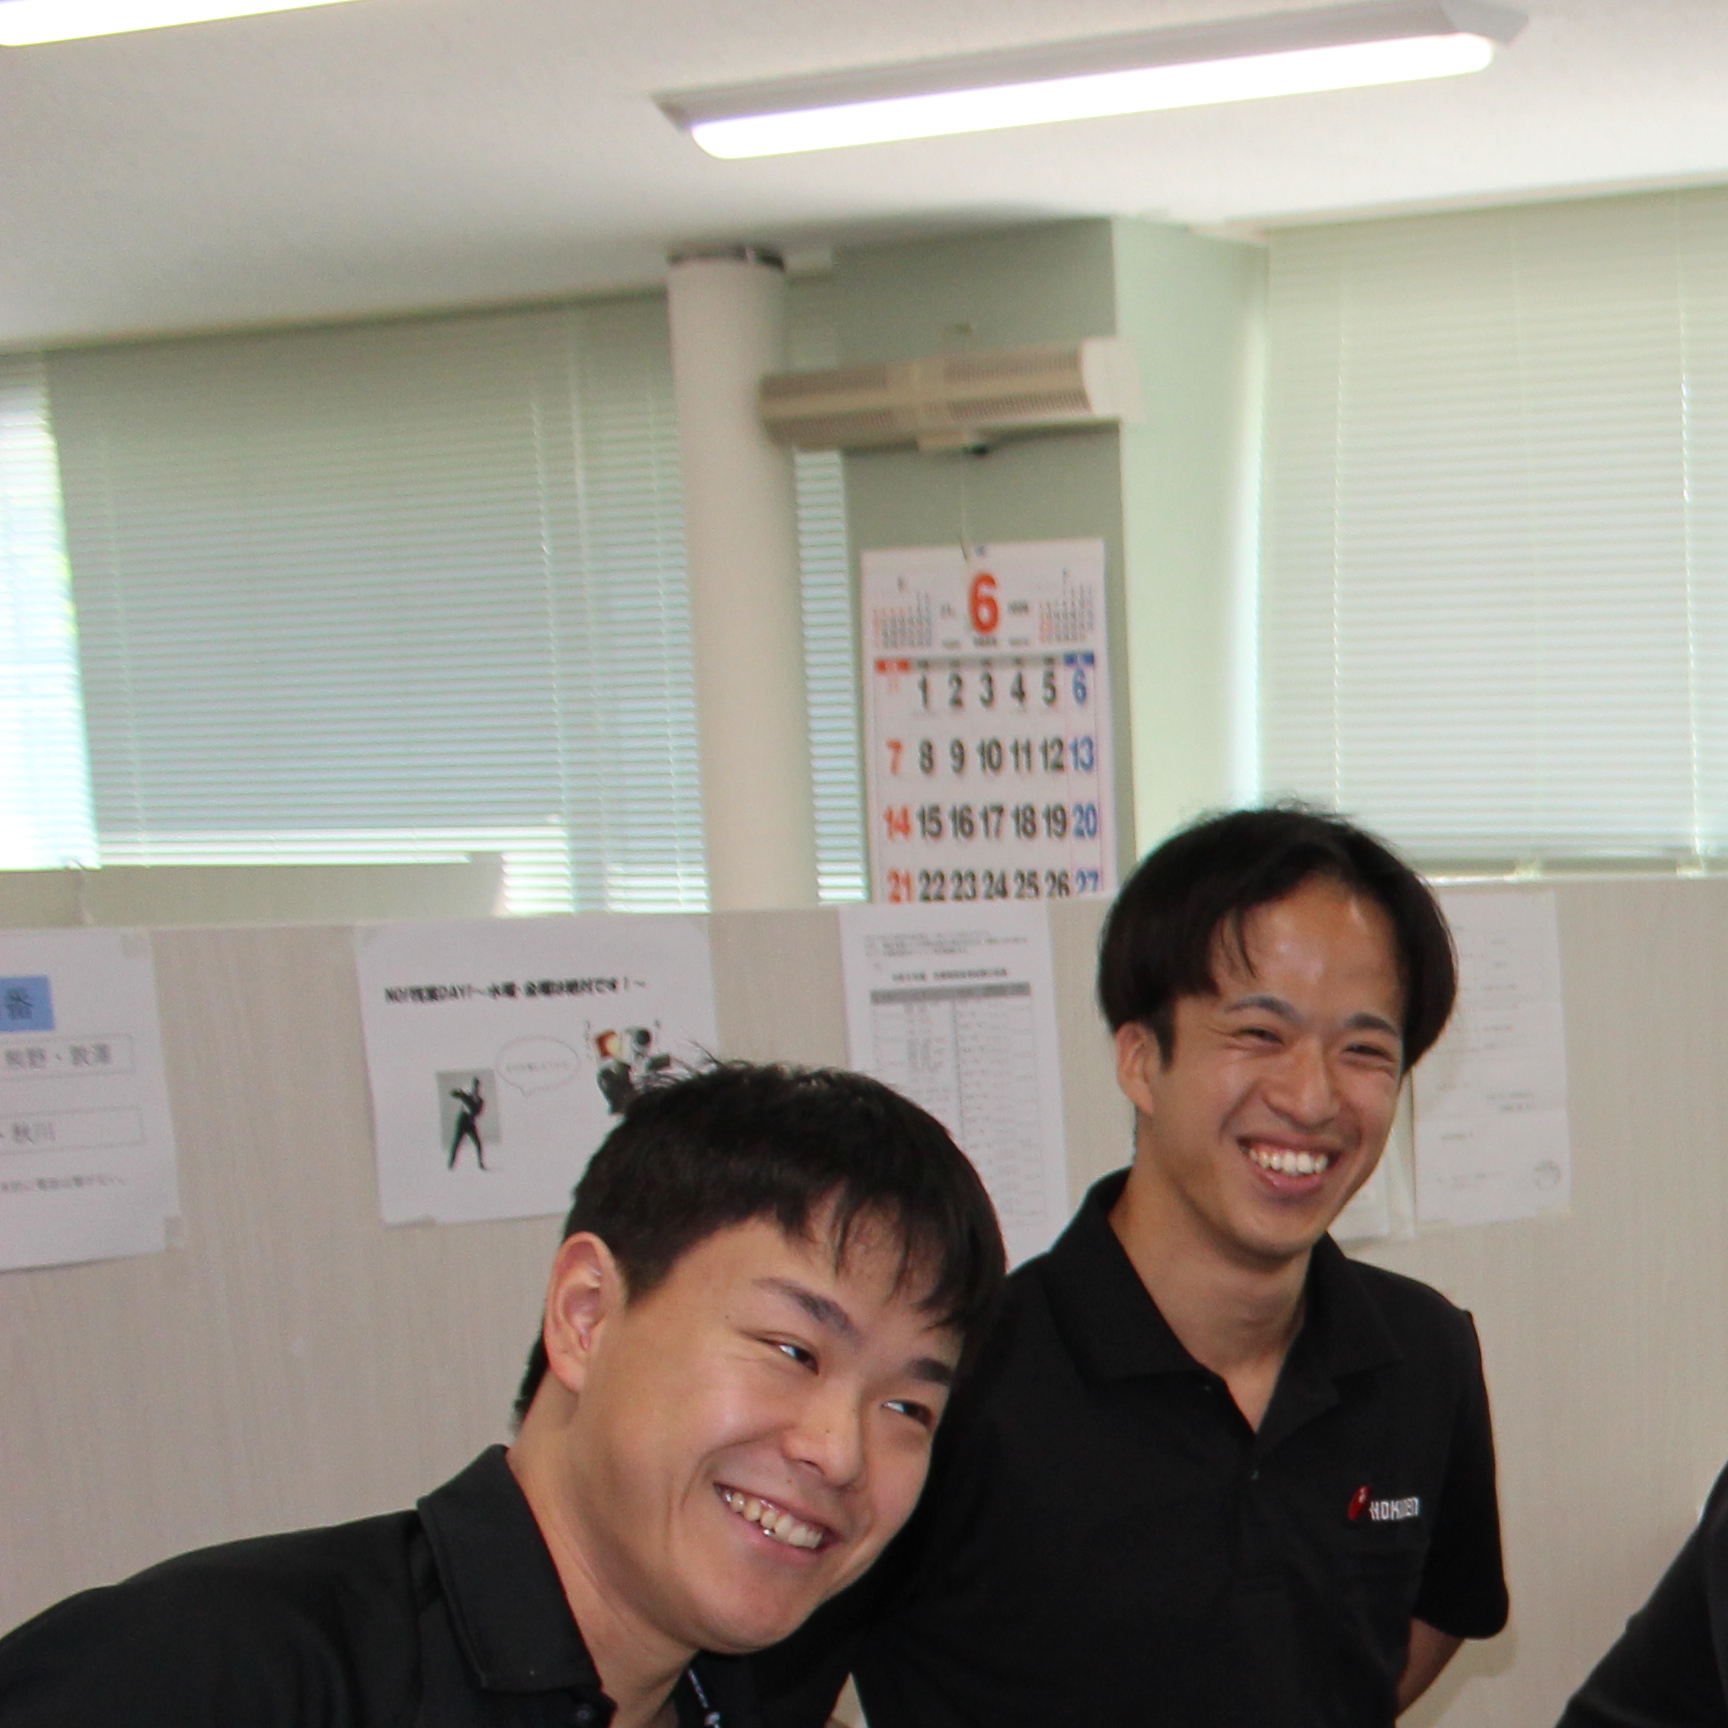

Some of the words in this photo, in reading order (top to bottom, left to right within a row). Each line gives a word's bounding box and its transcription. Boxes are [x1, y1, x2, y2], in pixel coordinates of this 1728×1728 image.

[969, 572, 999, 636] 6
[917, 673, 930, 708] 1
[949, 673, 963, 708] 2
[980, 672, 994, 706] 3
[1010, 671, 1026, 704] 4
[1043, 670, 1057, 704] 5
[1073, 671, 1088, 703] 6
[886, 741, 904, 774] 7
[918, 739, 934, 774] 8
[951, 739, 965, 774] 9
[979, 739, 1002, 773] 10
[1009, 738, 1032, 772] 11
[1041, 738, 1065, 772] 12
[1069, 737, 1094, 771] 13
[884, 806, 911, 840] 14
[918, 806, 943, 840] 15
[950, 806, 975, 839] 16
[980, 806, 1004, 839] 17
[1012, 806, 1037, 839] 18
[1043, 805, 1067, 838] 19
[1073, 804, 1098, 838] 20
[888, 870, 912, 902] 21
[918, 870, 945, 901] 22
[950, 870, 977, 900] 23
[983, 870, 1008, 899] 24
[1014, 870, 1039, 898] 25
[1045, 870, 1071, 897] 26
[1075, 871, 1099, 892] 27
